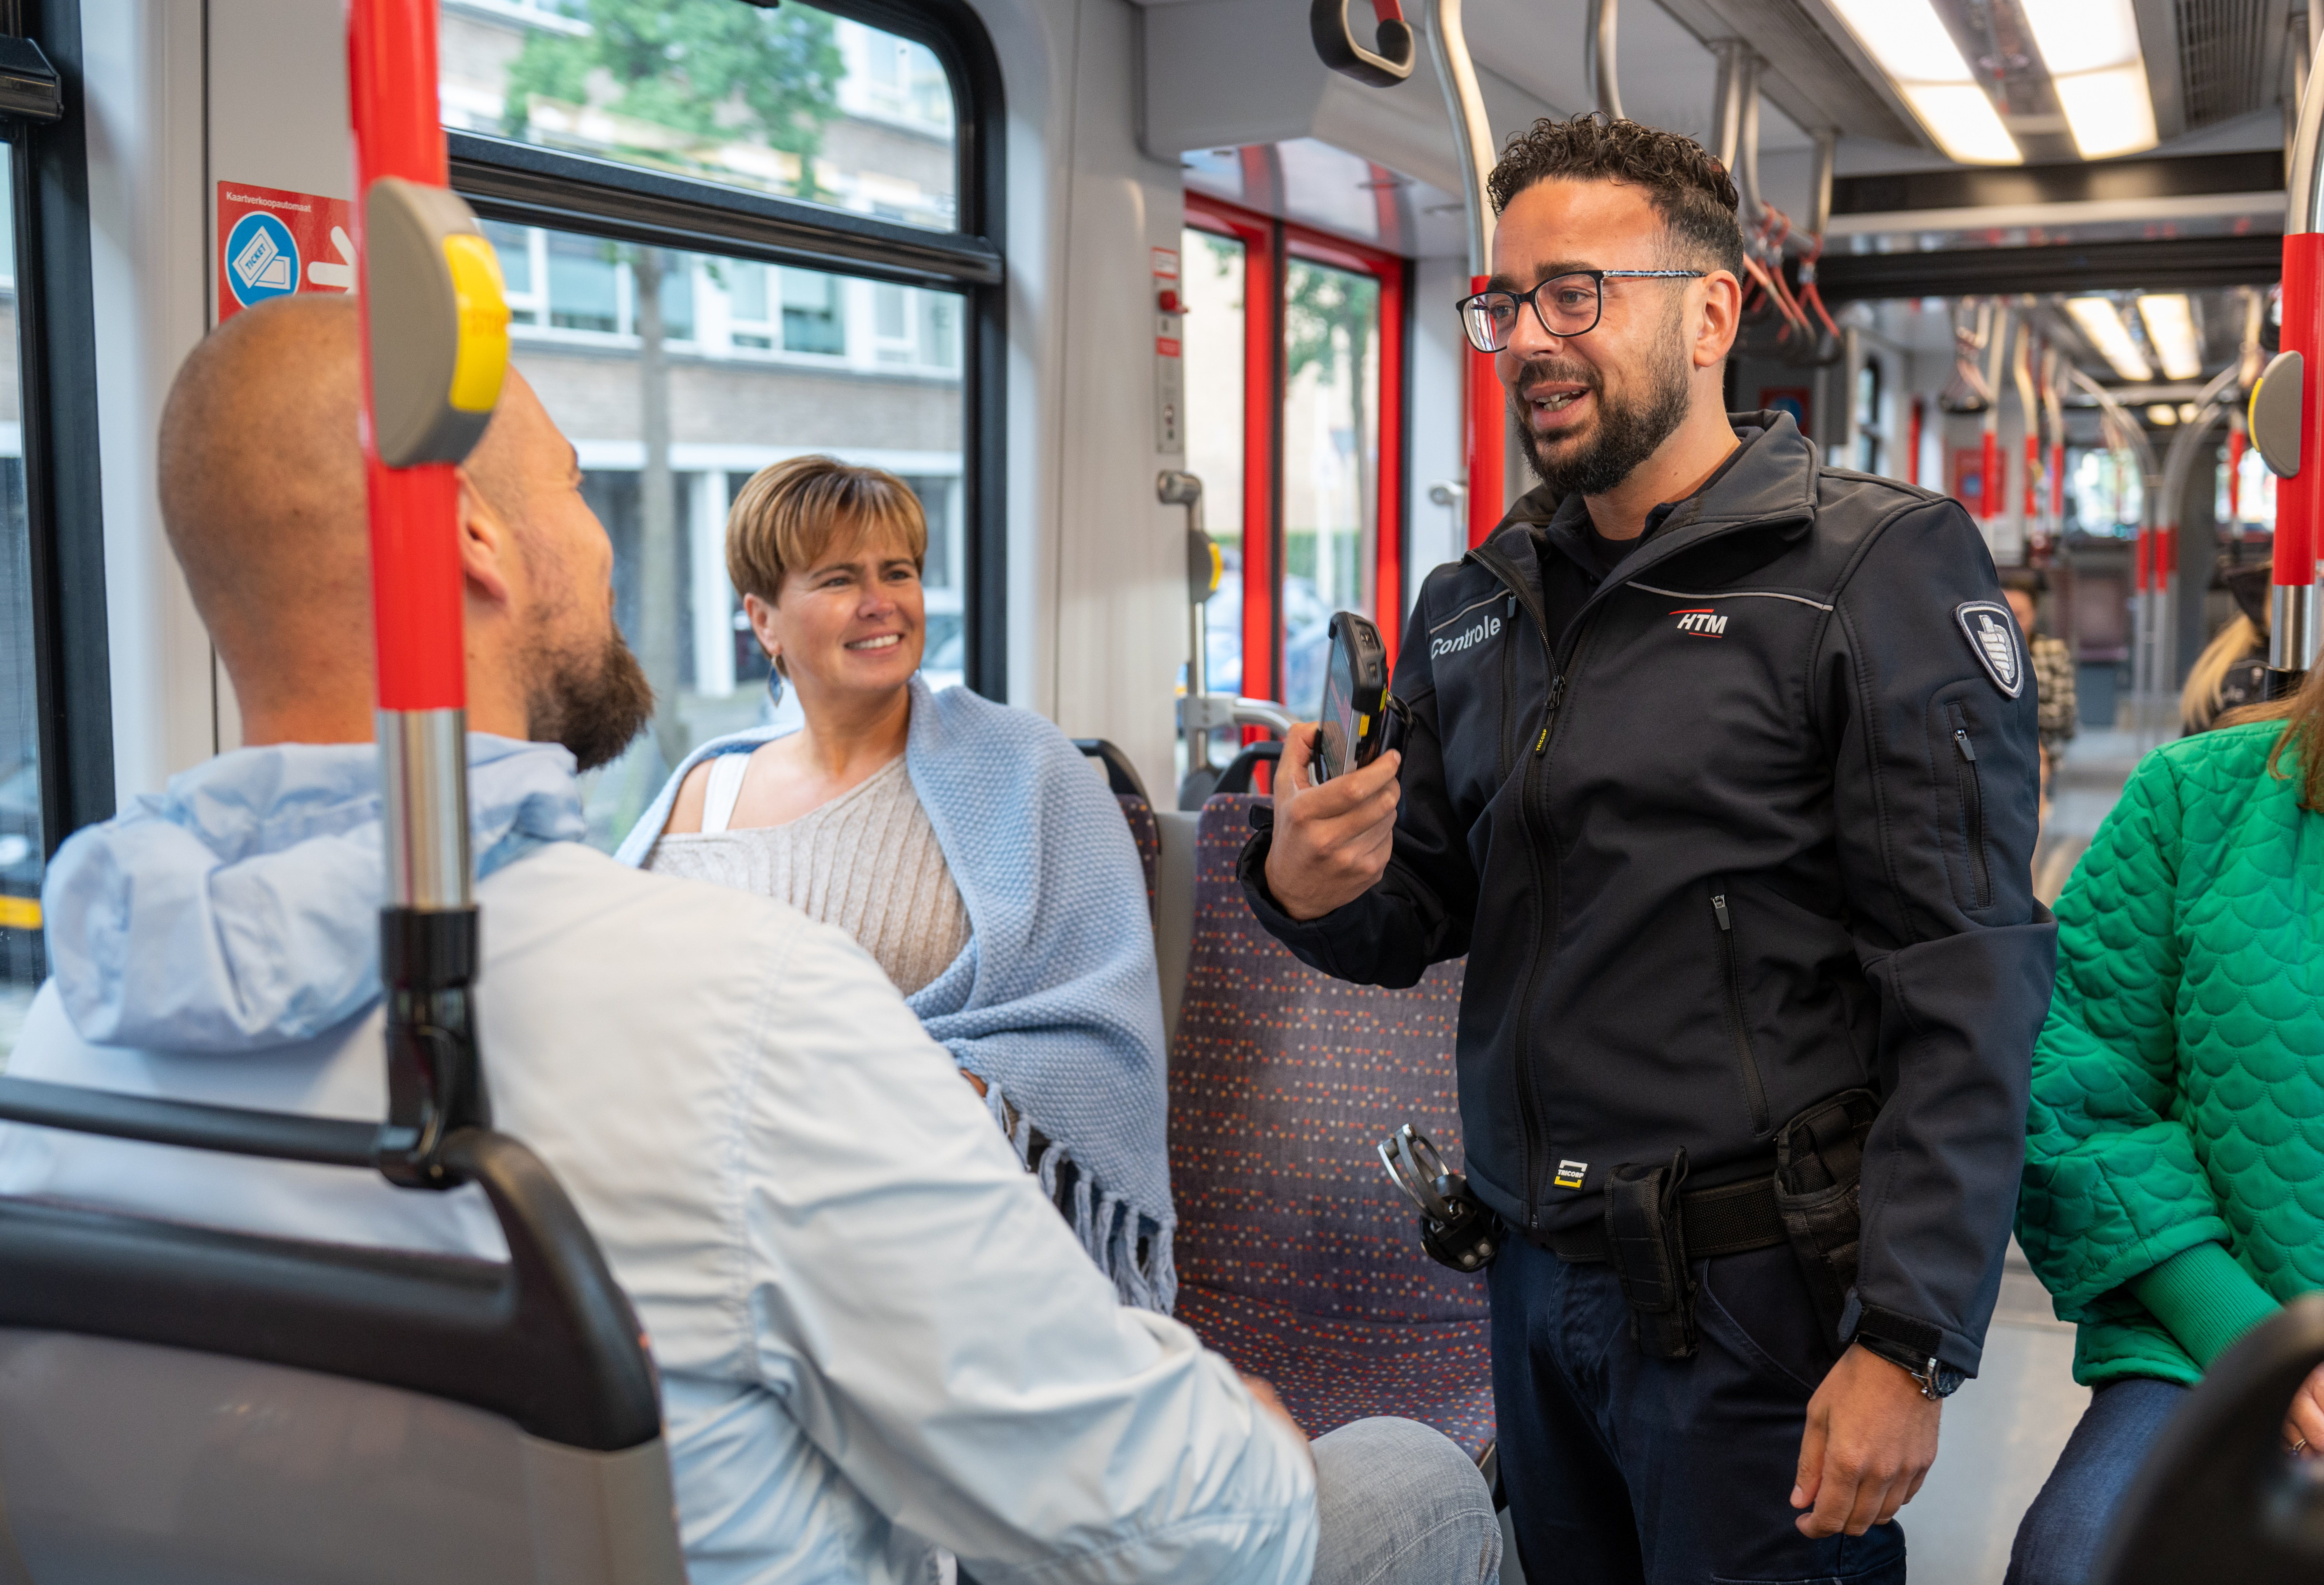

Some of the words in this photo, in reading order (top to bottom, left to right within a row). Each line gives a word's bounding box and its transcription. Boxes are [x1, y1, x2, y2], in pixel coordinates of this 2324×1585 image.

[226, 191, 311, 213] Kaartverkoopautomaat
[245, 243, 266, 270] TICKET
[1677, 613, 1728, 634] HTM
[1432, 615, 1501, 660] Controle
[1536, 729, 1546, 751] TRICORP
[1558, 1169, 1584, 1178] TRICORP
